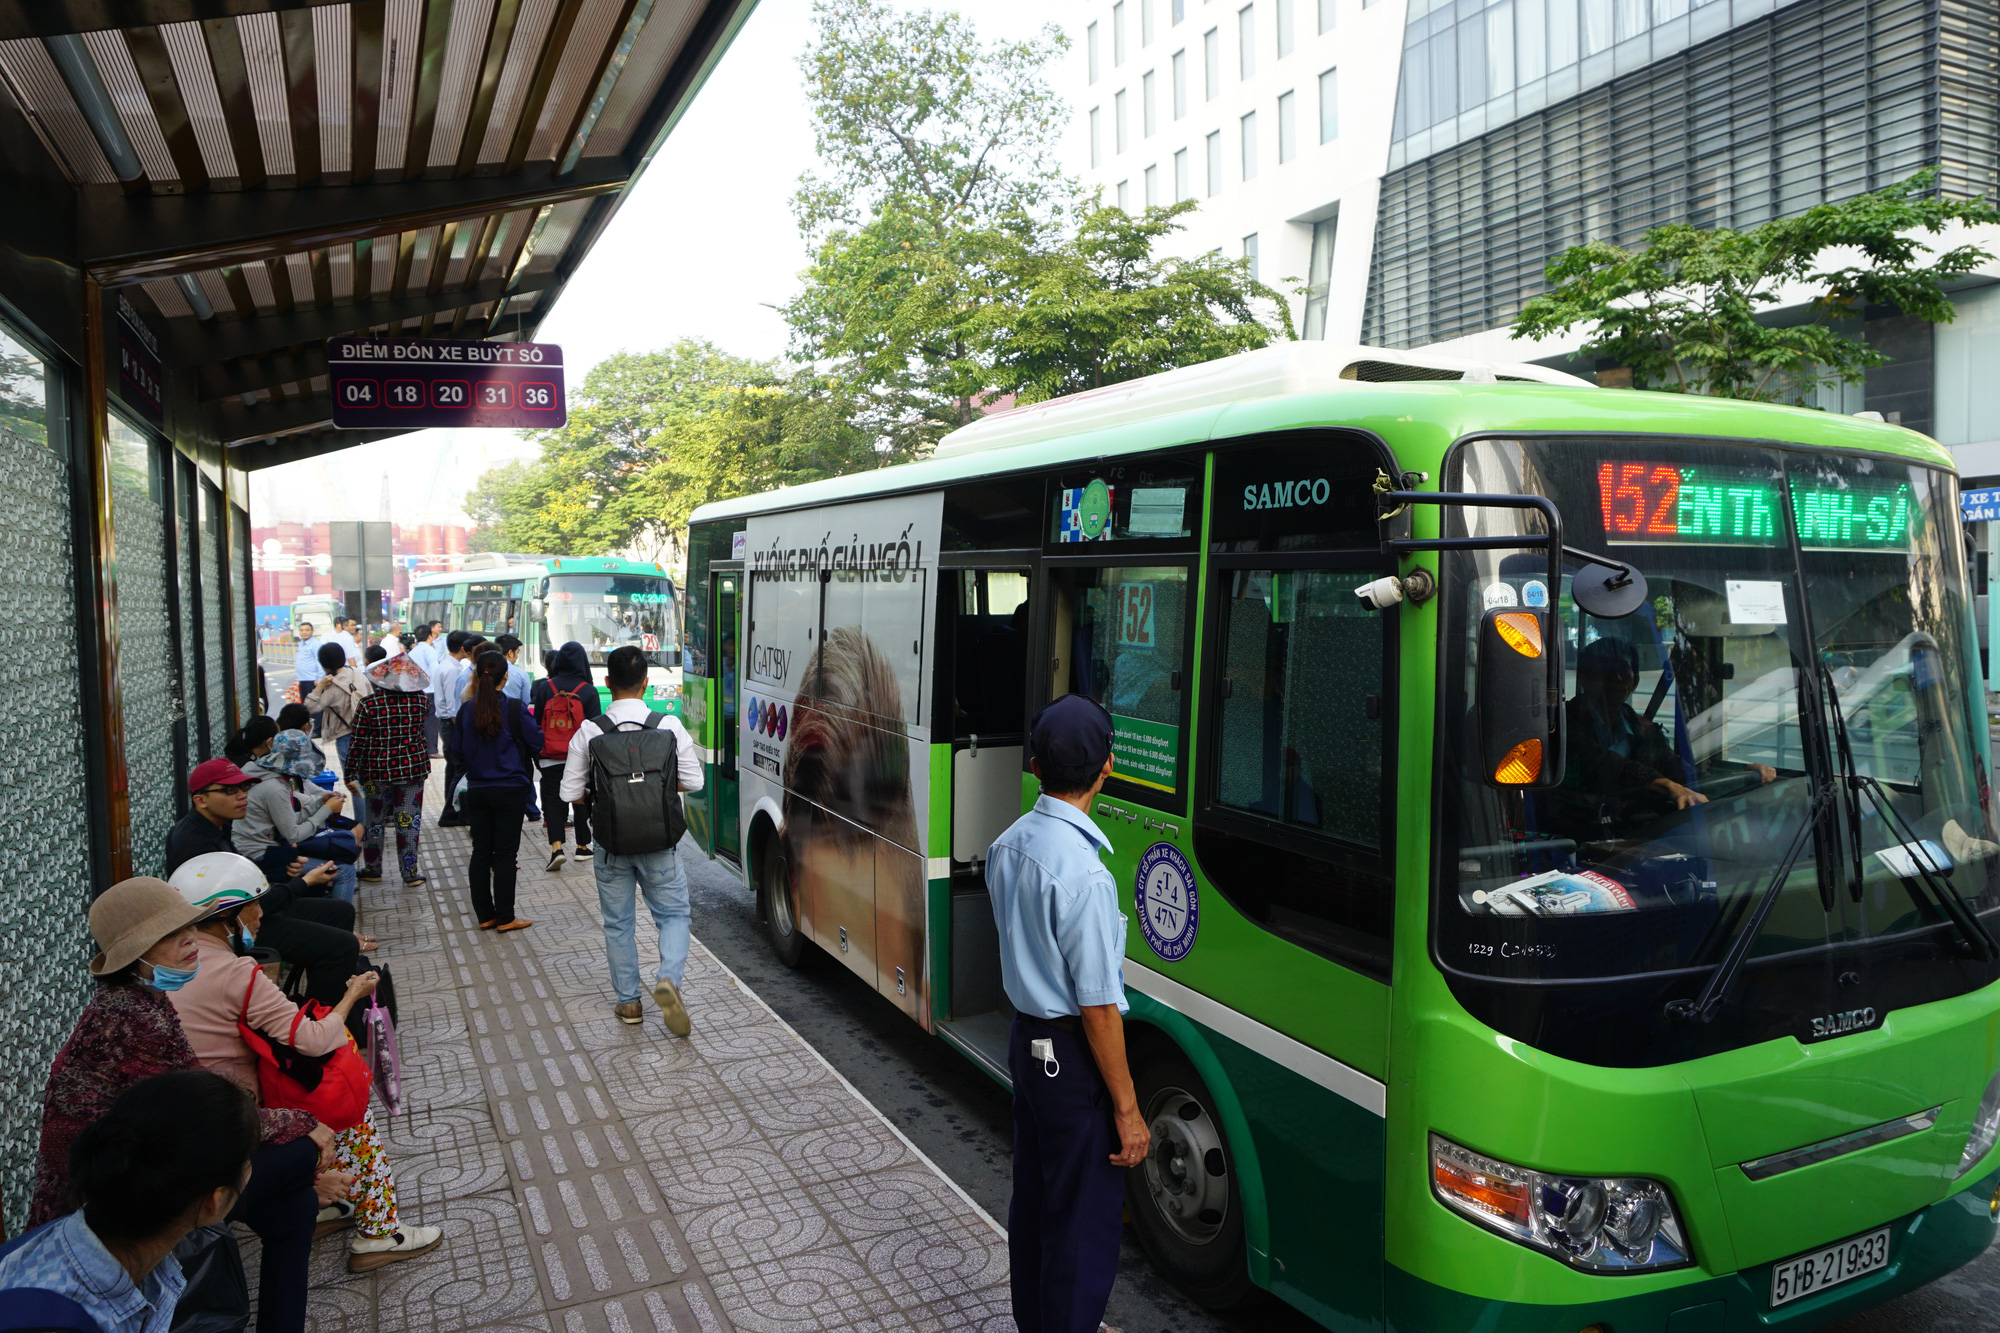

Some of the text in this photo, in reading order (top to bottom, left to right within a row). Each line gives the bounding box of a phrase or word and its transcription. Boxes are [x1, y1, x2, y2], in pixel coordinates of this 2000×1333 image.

[393, 342, 433, 359] ĐÓN
[439, 346, 462, 360] XE
[467, 345, 514, 362] BUÝT
[346, 385, 549, 405] 04 18 20 31 36
[1243, 477, 1331, 511] SAMCO
[1597, 463, 1680, 534] 152
[1969, 492, 1989, 505] XE
[753, 536, 797, 583] XUỐNG
[799, 531, 831, 583] PHỐ
[832, 533, 865, 583] GIẢI
[865, 522, 914, 584] NGỐ
[1117, 585, 1152, 644] 152
[643, 634, 660, 651] 20
[753, 644, 792, 688] GATSBY
[1097, 802, 1138, 825] CITY
[1161, 848, 1169, 858] XE
[1170, 850, 1187, 874] KHÁCH
[1184, 872, 1194, 889] SÀI
[1189, 891, 1197, 911] GÒN
[1138, 904, 1195, 956] THÀNH PHỐ HỒ CHÍ MINH
[1154, 906, 1178, 931] 47N
[1468, 943, 1494, 956] 1229
[1809, 1006, 1877, 1038] SAMCO
[1776, 1232, 1887, 1301] 51B-219.33
